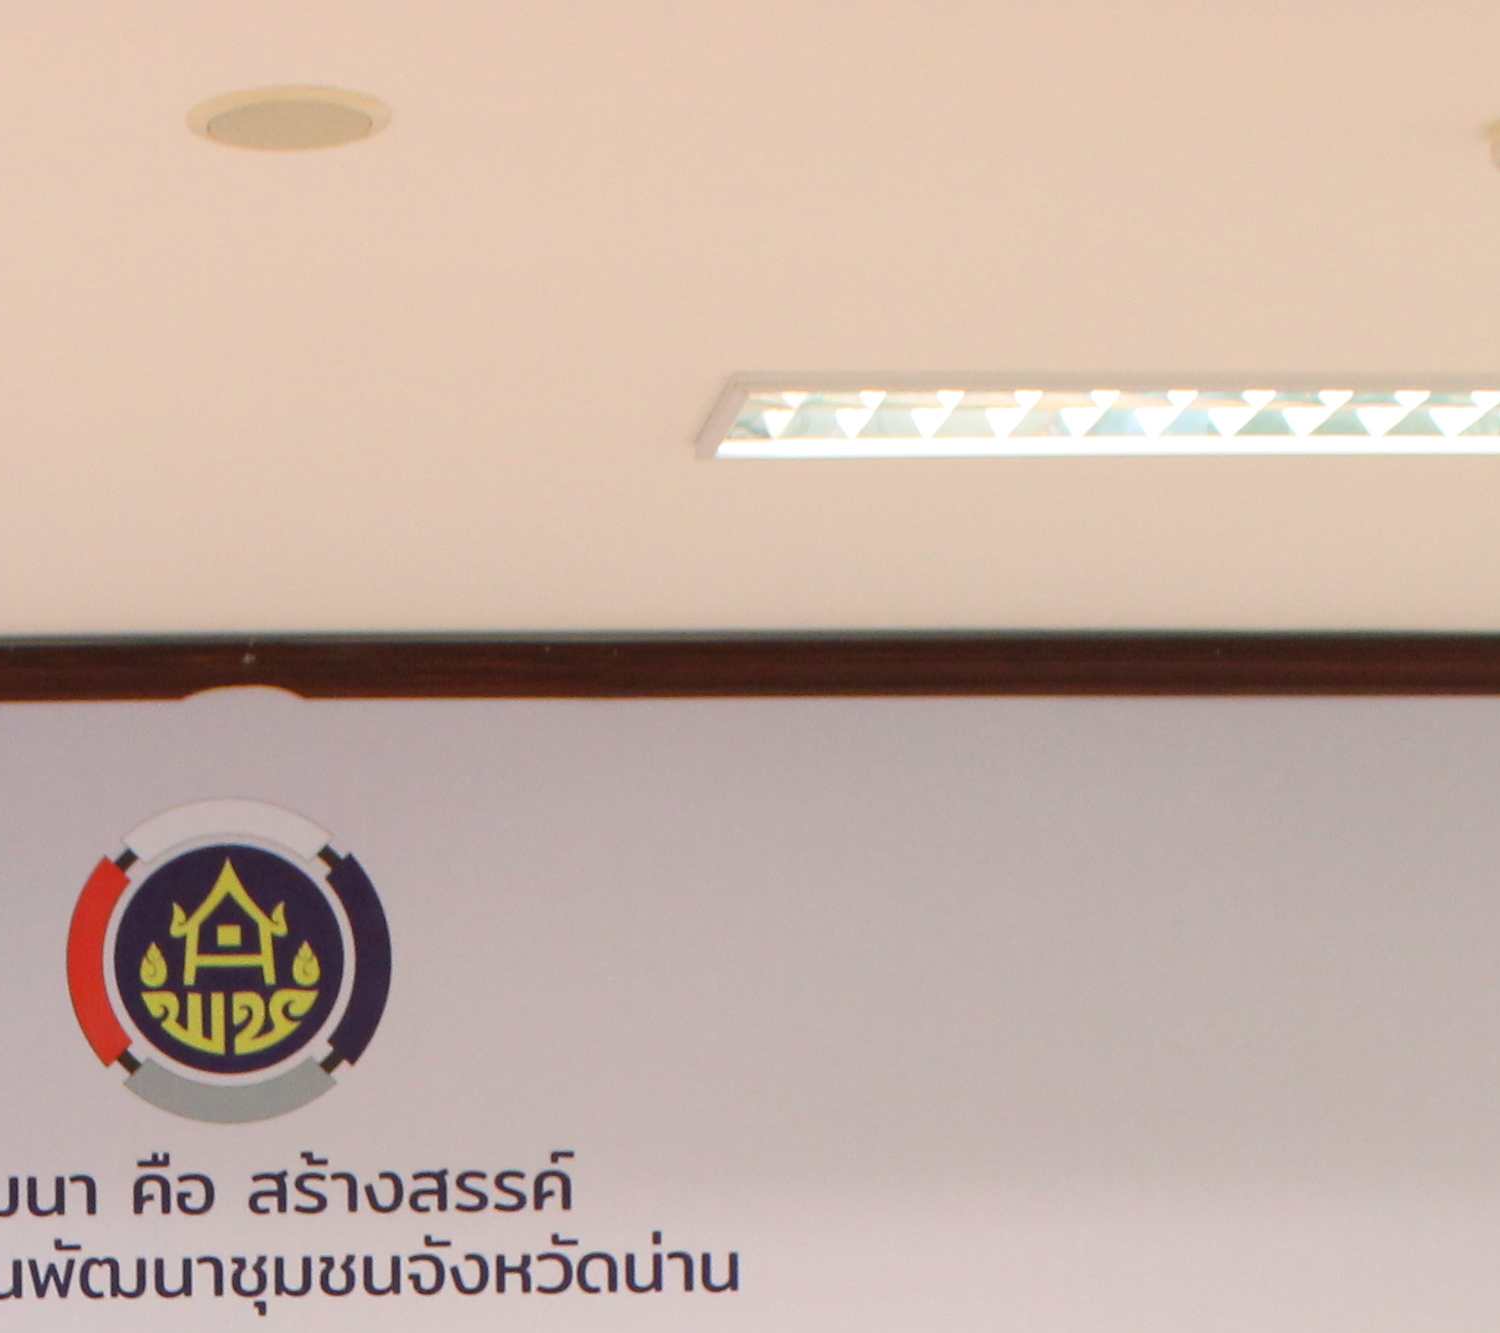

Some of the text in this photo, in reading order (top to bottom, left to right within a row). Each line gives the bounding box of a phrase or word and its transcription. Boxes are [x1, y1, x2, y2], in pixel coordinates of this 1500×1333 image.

[132, 1151, 216, 1216] คือ
[247, 1149, 577, 1215] สร้างสรรค์
